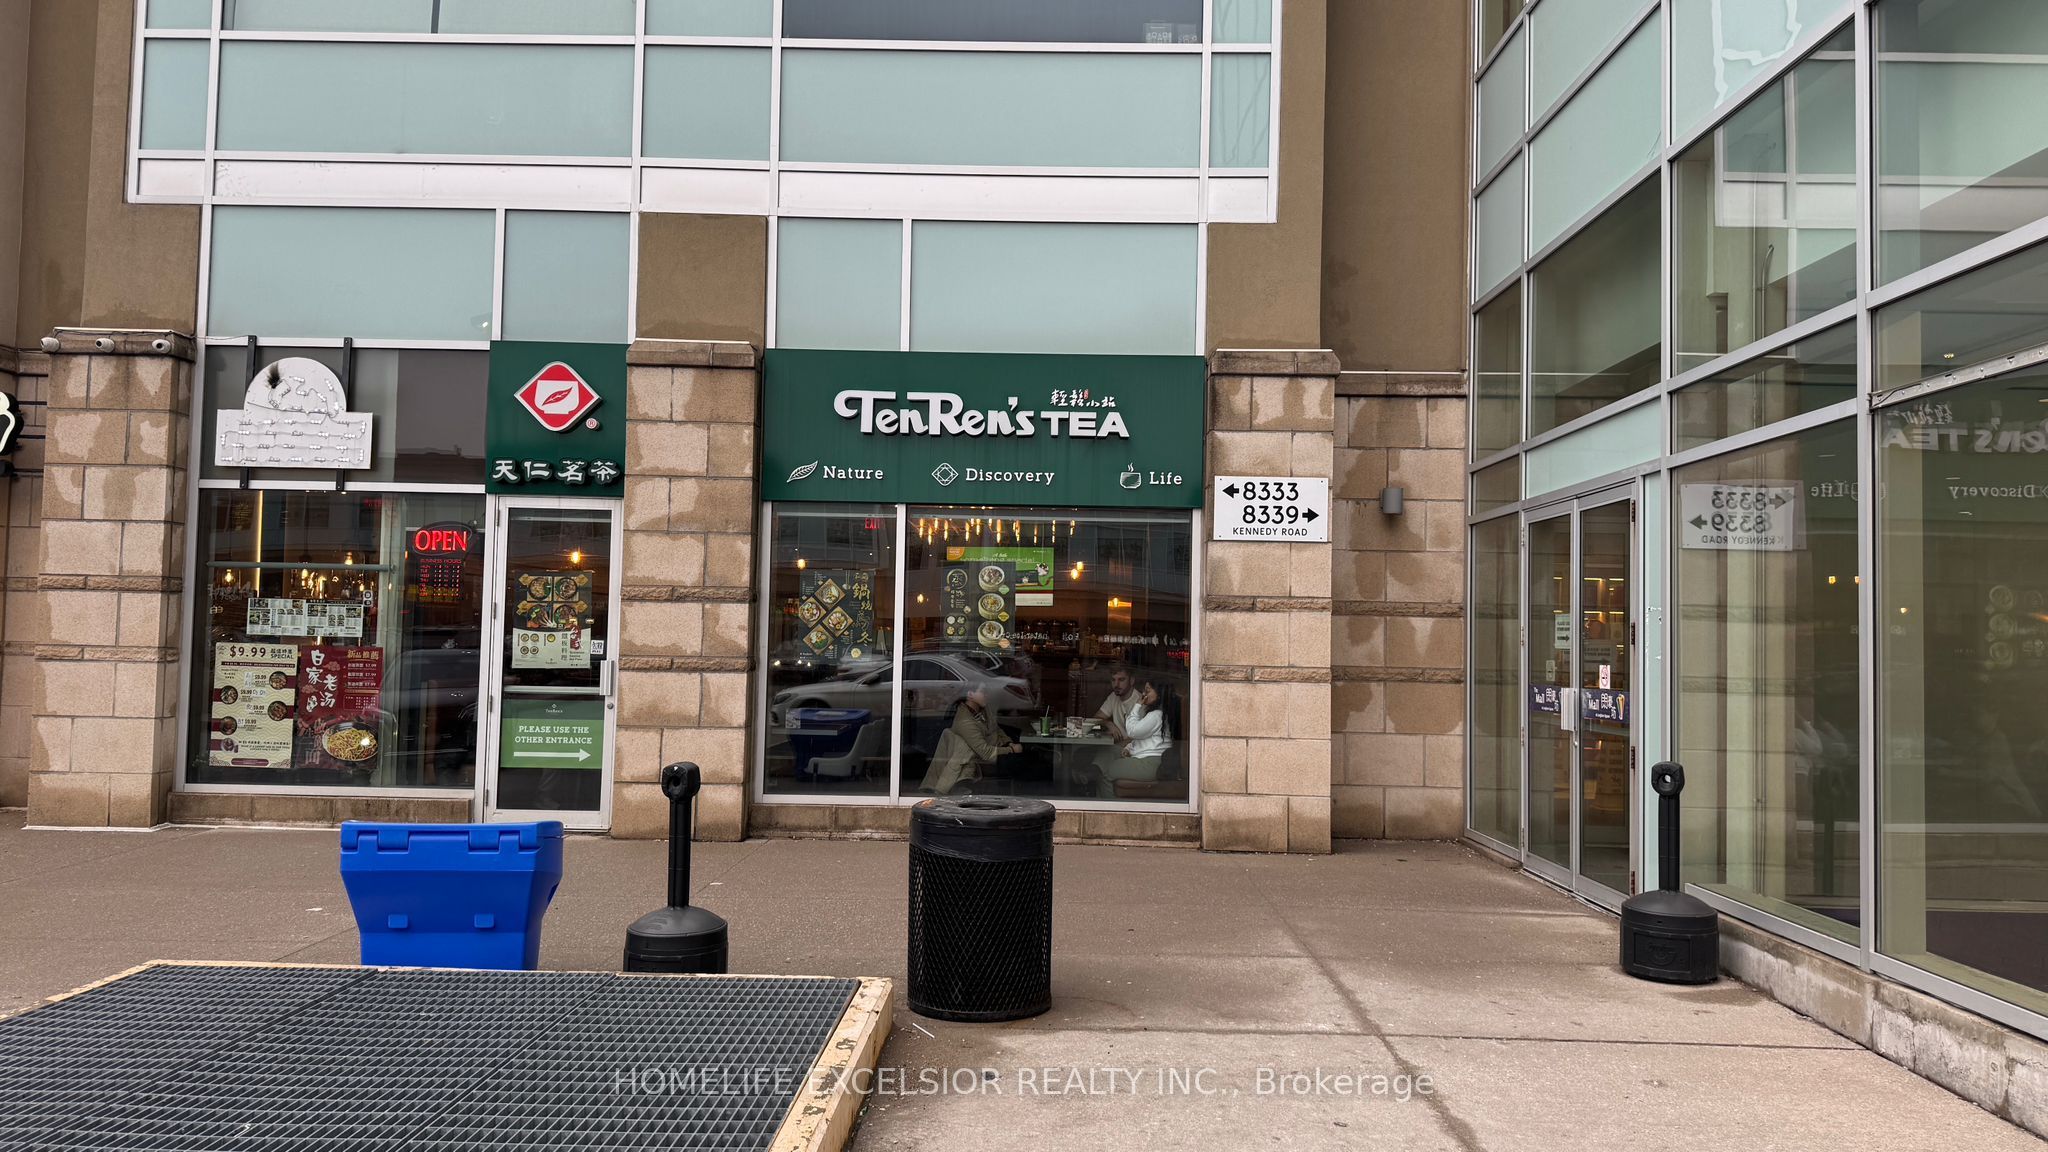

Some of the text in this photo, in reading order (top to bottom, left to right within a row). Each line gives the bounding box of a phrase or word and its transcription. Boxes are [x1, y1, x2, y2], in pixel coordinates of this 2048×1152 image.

[1040, 411, 1130, 438] TEA
[492, 459, 618, 482] 天仁茗茶
[823, 465, 884, 480] Nature
[965, 468, 1055, 486] Discovery
[1149, 471, 1183, 485] Life
[1242, 481, 1299, 501] 8333
[1242, 504, 1299, 524] 8339
[1232, 527, 1308, 536] KENNEDY ROAD
[415, 529, 467, 551] OPEN
[229, 645, 266, 658] $9.99
[1588, 699, 1600, 710] Mall
[518, 725, 590, 734] PLEASE USE THE
[514, 736, 593, 745] OTHER ENTRANCE
